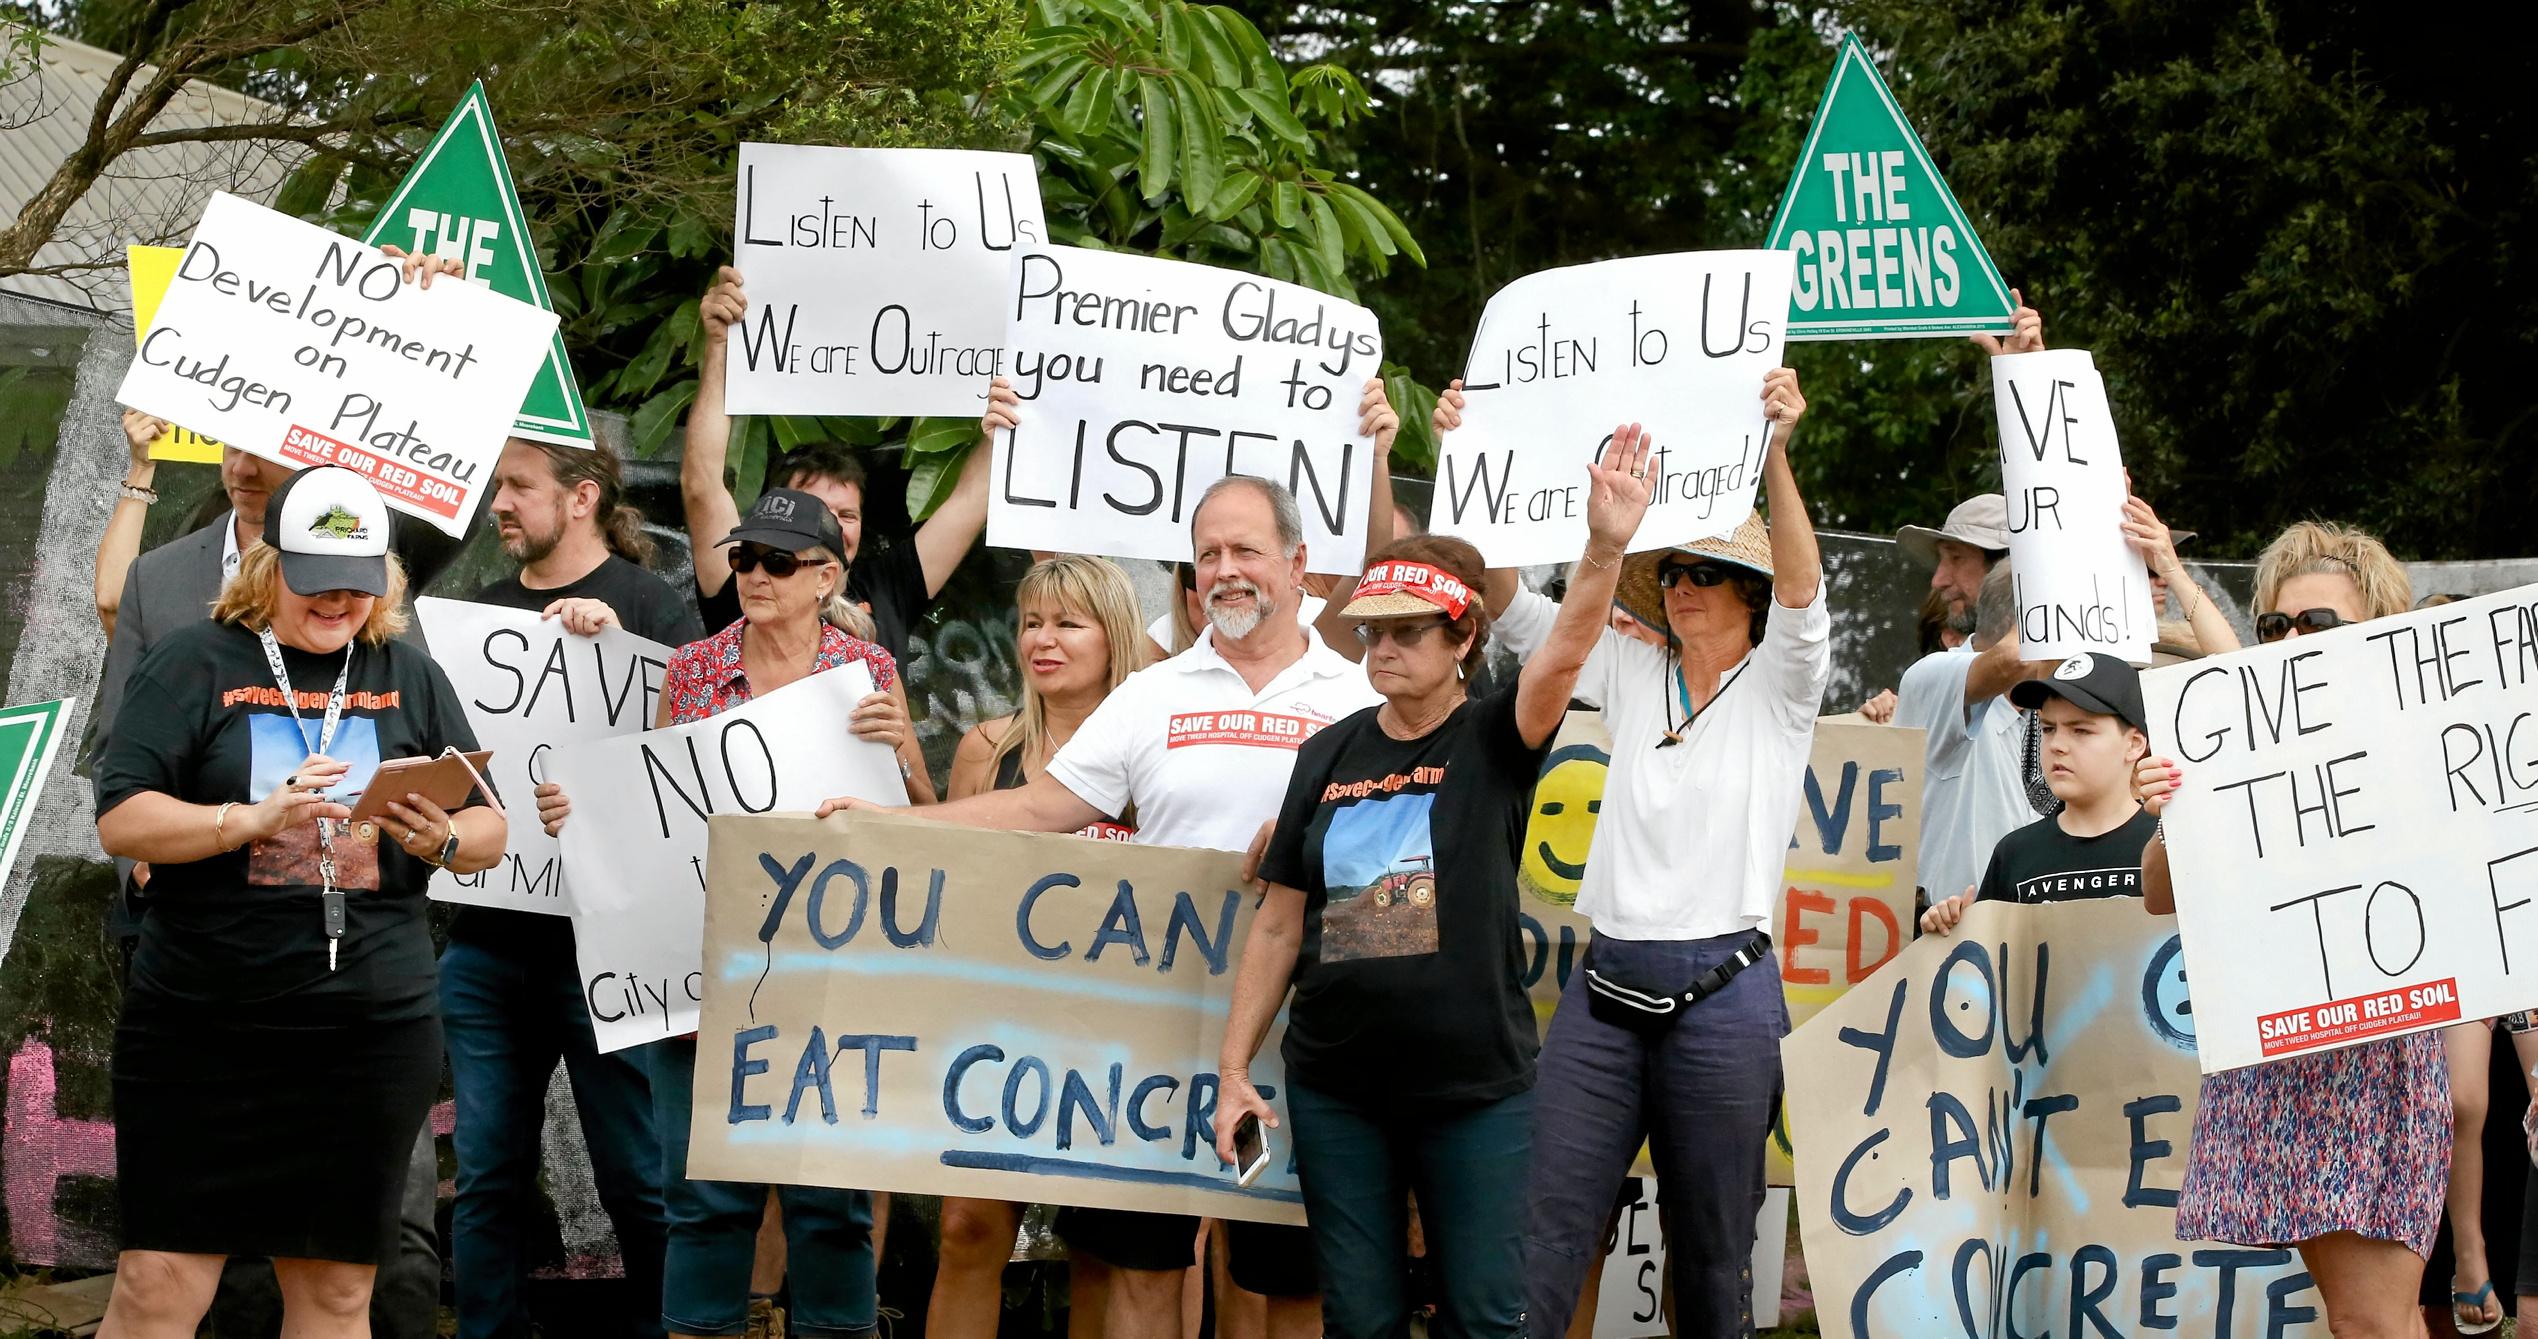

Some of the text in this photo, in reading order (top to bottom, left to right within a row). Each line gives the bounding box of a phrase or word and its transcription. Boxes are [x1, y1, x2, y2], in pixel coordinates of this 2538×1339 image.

[917, 198, 957, 251] to
[1822, 150, 1911, 222] THE
[315, 242, 402, 302] NO
[407, 207, 501, 290] THE
[1788, 225, 1961, 312] GREENS
[177, 240, 478, 380] Development
[1016, 254, 1378, 377] Premier Gladys
[1628, 299, 1669, 368] to
[141, 327, 292, 414] Cudgen
[295, 344, 348, 379] on
[1012, 351, 1333, 411] you need to
[283, 444, 303, 457] MOVE
[302, 451, 327, 466] TWEED
[286, 428, 461, 508] SAVE OUR RED SOIL
[2004, 486, 2063, 534] UR
[1392, 564, 1429, 585] RED
[1431, 574, 1469, 606] SOIL
[474, 628, 670, 732] SAVE
[2174, 603, 2538, 763] GIVE THE FA
[1169, 735, 1187, 744] MOVE
[1208, 731, 1239, 741] HOSPITAL
[1239, 732, 1253, 740] OFF
[1253, 733, 1282, 743] CUDGEN
[1170, 716, 1215, 735] SAVE
[1217, 714, 1257, 732] OUR
[1262, 716, 1301, 736] RED
[640, 717, 778, 840] NO
[2213, 712, 2538, 859] THE RIG
[758, 851, 948, 952] YOU
[1781, 886, 1901, 986] ED
[2270, 881, 2426, 1001] TO
[588, 971, 671, 1032] City
[1838, 939, 2050, 1118] YOU
[2260, 983, 2456, 1040] SAVE OUR RED SOIL
[2264, 1012, 2422, 1050] MOVE TWEED HOSPITAL OFF CUDGEN PLATEAU!
[728, 1025, 920, 1126] EAT
[1831, 1068, 2080, 1236] CAN'T
